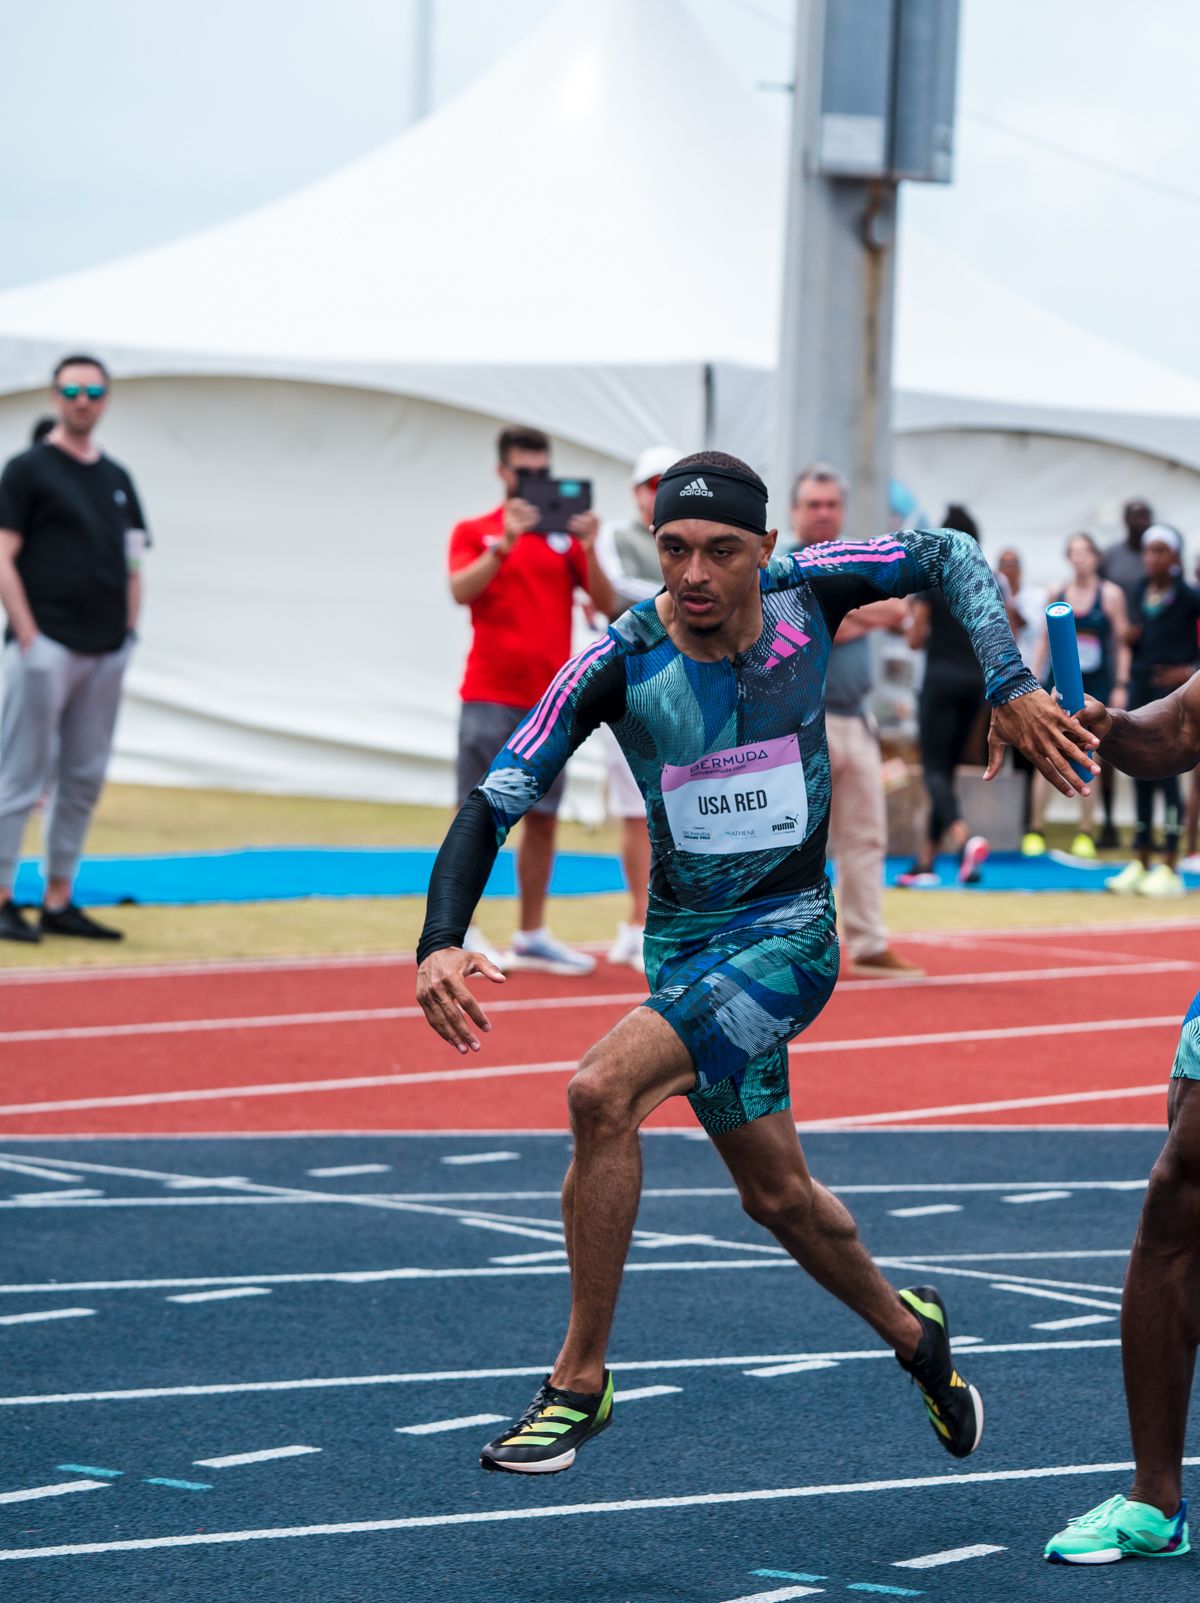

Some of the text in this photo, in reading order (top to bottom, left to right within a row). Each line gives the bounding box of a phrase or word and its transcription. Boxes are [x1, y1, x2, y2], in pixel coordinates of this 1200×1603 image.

[679, 488, 714, 498] adidas
[698, 789, 768, 815] USA RED
[771, 821, 794, 831] PUMA
